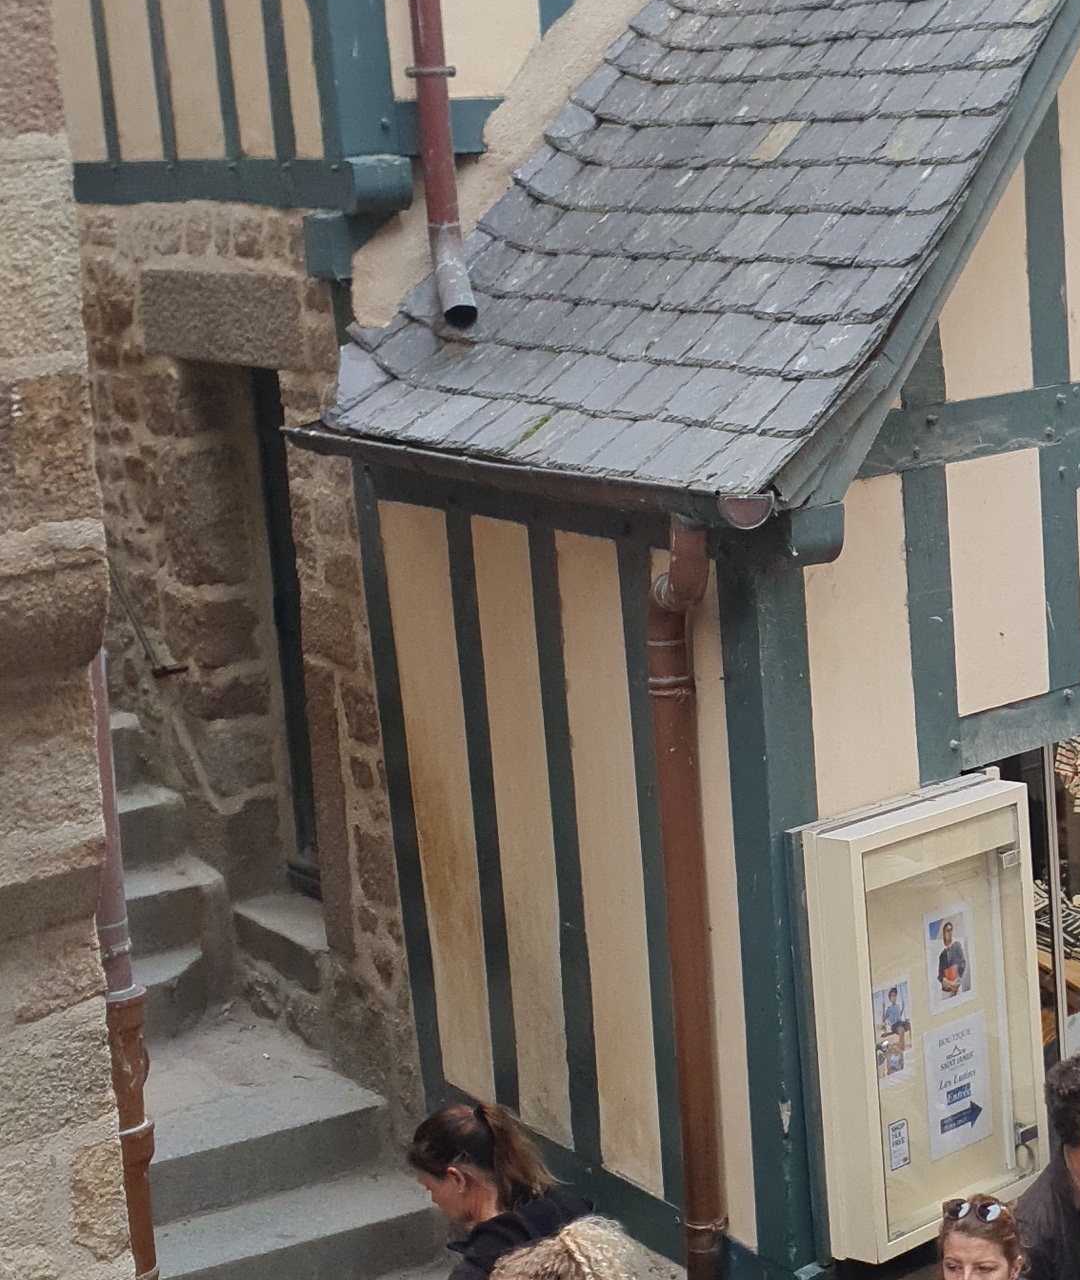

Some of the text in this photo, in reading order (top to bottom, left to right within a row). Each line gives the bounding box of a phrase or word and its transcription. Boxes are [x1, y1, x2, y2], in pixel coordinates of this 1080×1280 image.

[939, 1028, 971, 1047] BOUTIQUE
[939, 1069, 976, 1091] Les Lutins
